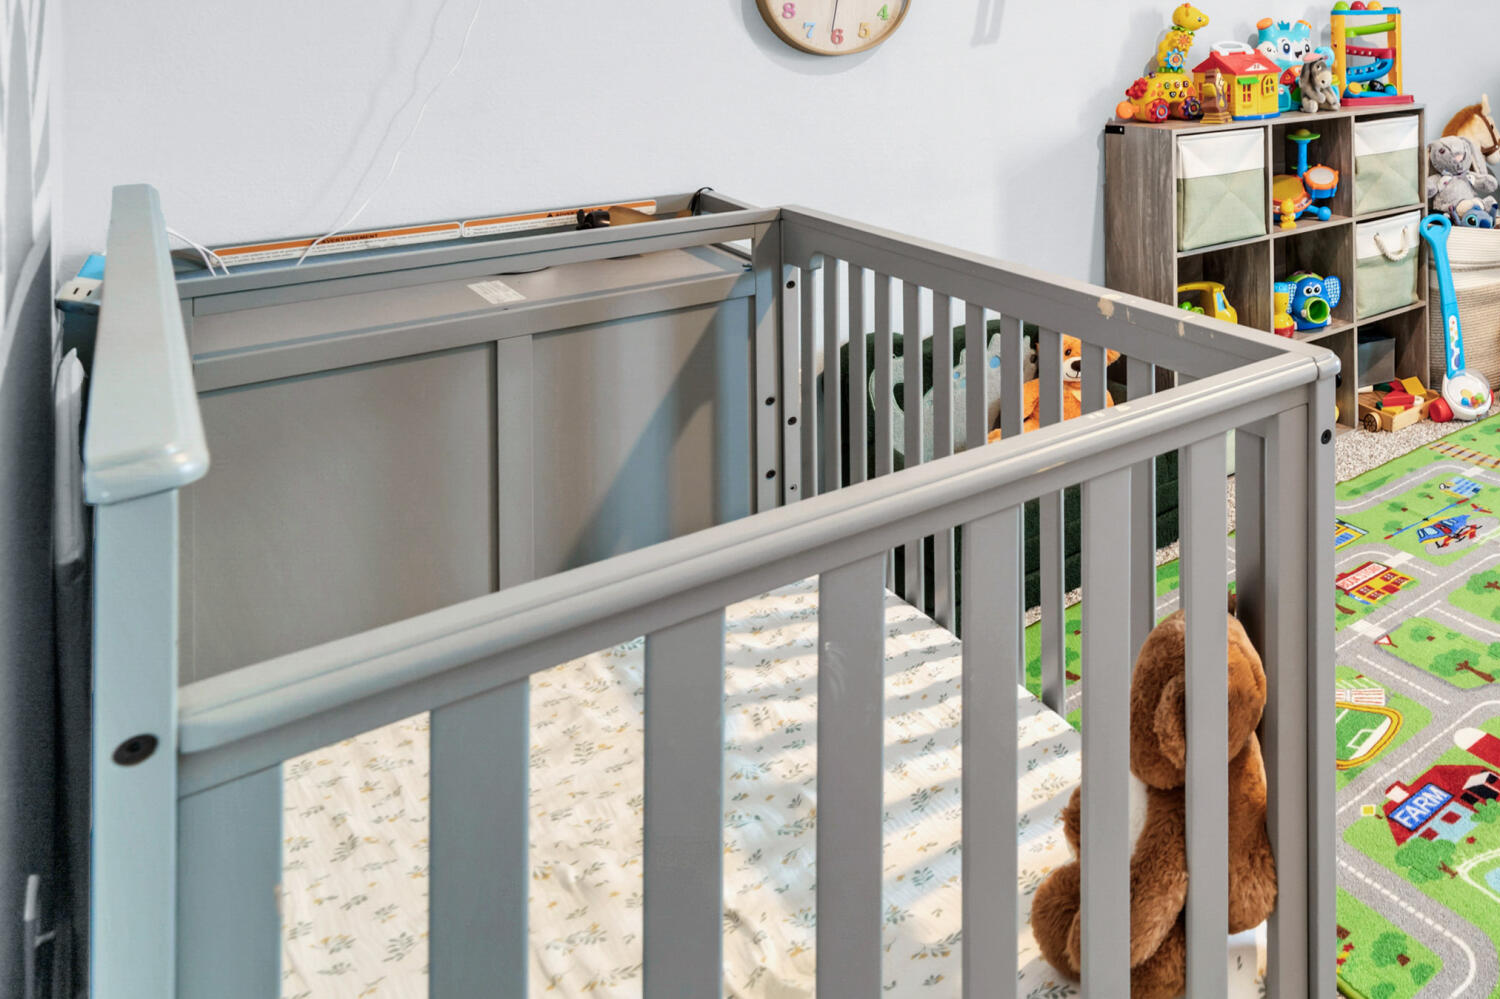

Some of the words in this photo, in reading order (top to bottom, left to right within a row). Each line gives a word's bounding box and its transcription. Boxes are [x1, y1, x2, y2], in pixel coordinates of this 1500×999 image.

[782, 2, 796, 19] 8
[877, 4, 888, 21] 4
[803, 22, 816, 39] 7
[831, 28, 844, 45] 6
[858, 22, 871, 39] 5
[1394, 785, 1448, 828] FARM
